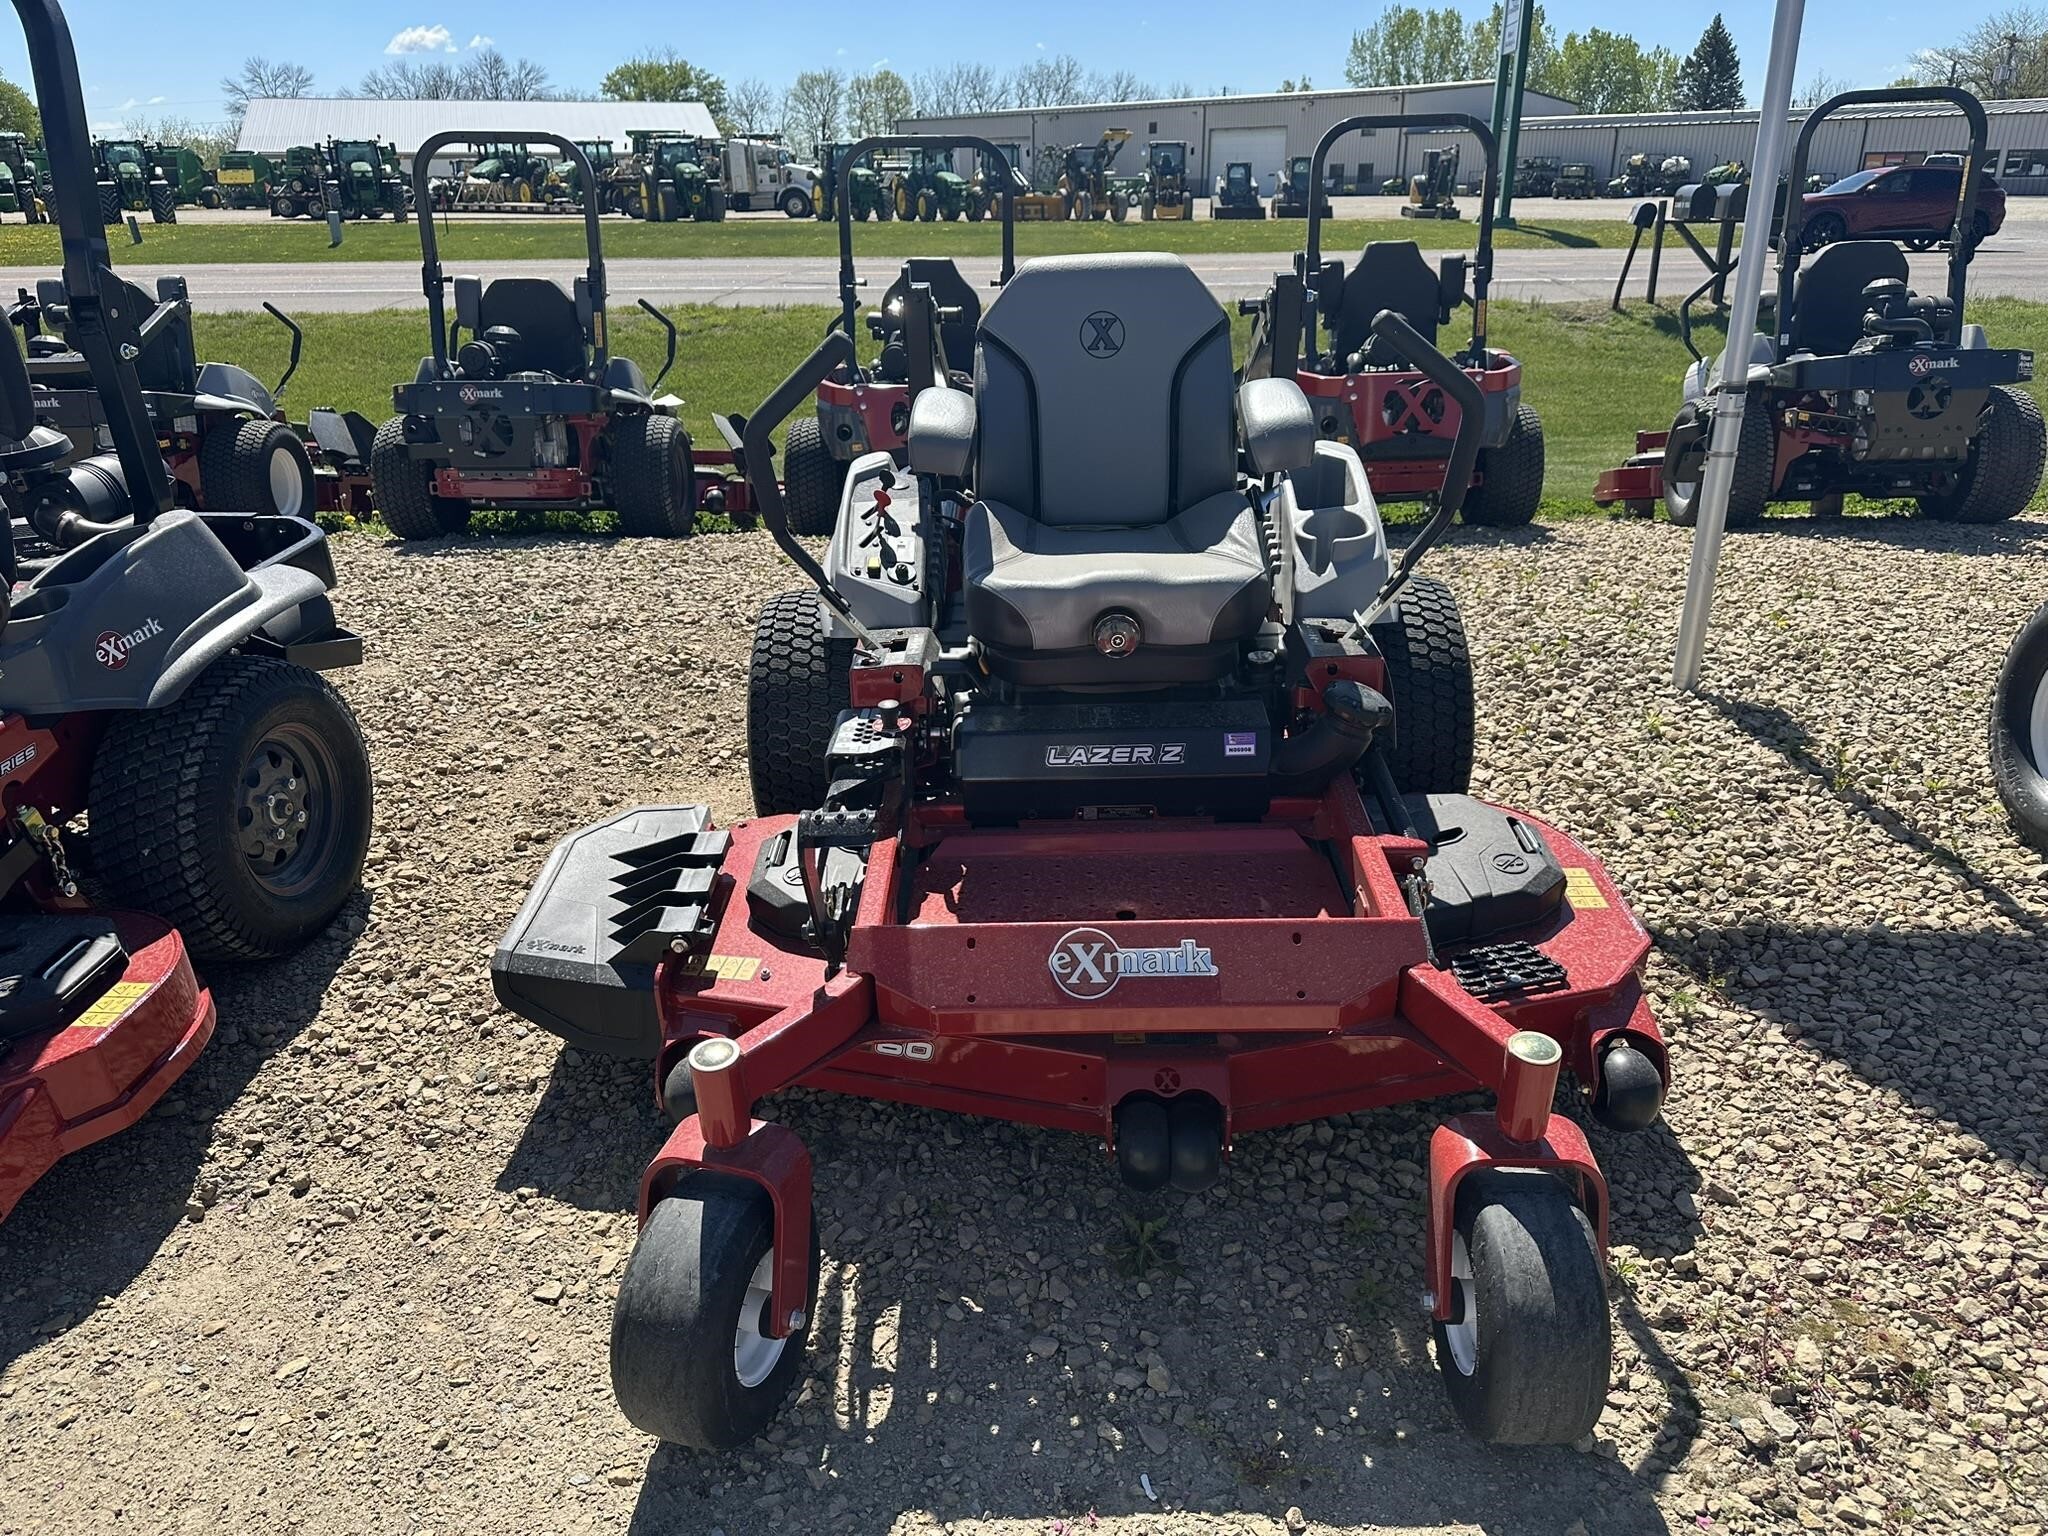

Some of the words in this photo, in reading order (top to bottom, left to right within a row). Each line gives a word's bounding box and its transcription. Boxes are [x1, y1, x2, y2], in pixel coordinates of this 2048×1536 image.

[1908, 357, 1960, 373] eXmark
[34, 398, 61, 408] mark
[459, 387, 504, 401] eXmark
[95, 617, 164, 666] eXmark
[0, 744, 36, 776] RIES
[1047, 744, 1155, 766] LAZER
[1159, 744, 1185, 764] Z
[1050, 941, 1213, 984] eXmark
